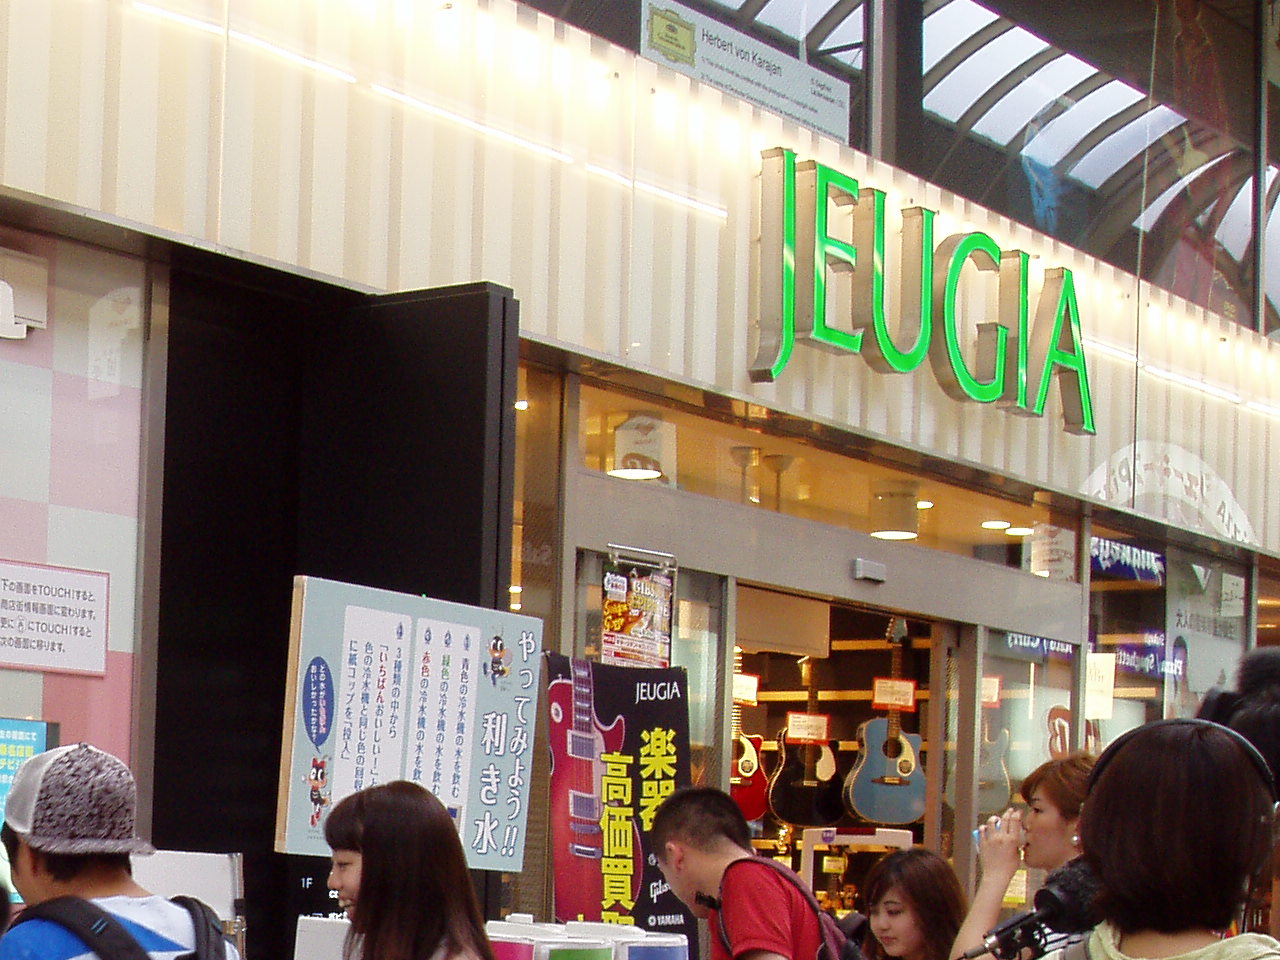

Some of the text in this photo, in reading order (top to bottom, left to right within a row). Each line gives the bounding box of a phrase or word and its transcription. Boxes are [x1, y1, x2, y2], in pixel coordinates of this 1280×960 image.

[701, 28, 733, 55] Herbert
[734, 44, 751, 61] von
[751, 51, 783, 78] Karajan
[765, 147, 1097, 436] JEUGIA
[413, 651, 432, 783] 赤色の冷水機の水を飲
[635, 681, 682, 704] JEUGIA
[472, 711, 509, 854] 利き水
[301, 877, 314, 889] 1F
[657, 913, 685, 926] YAMAHA
